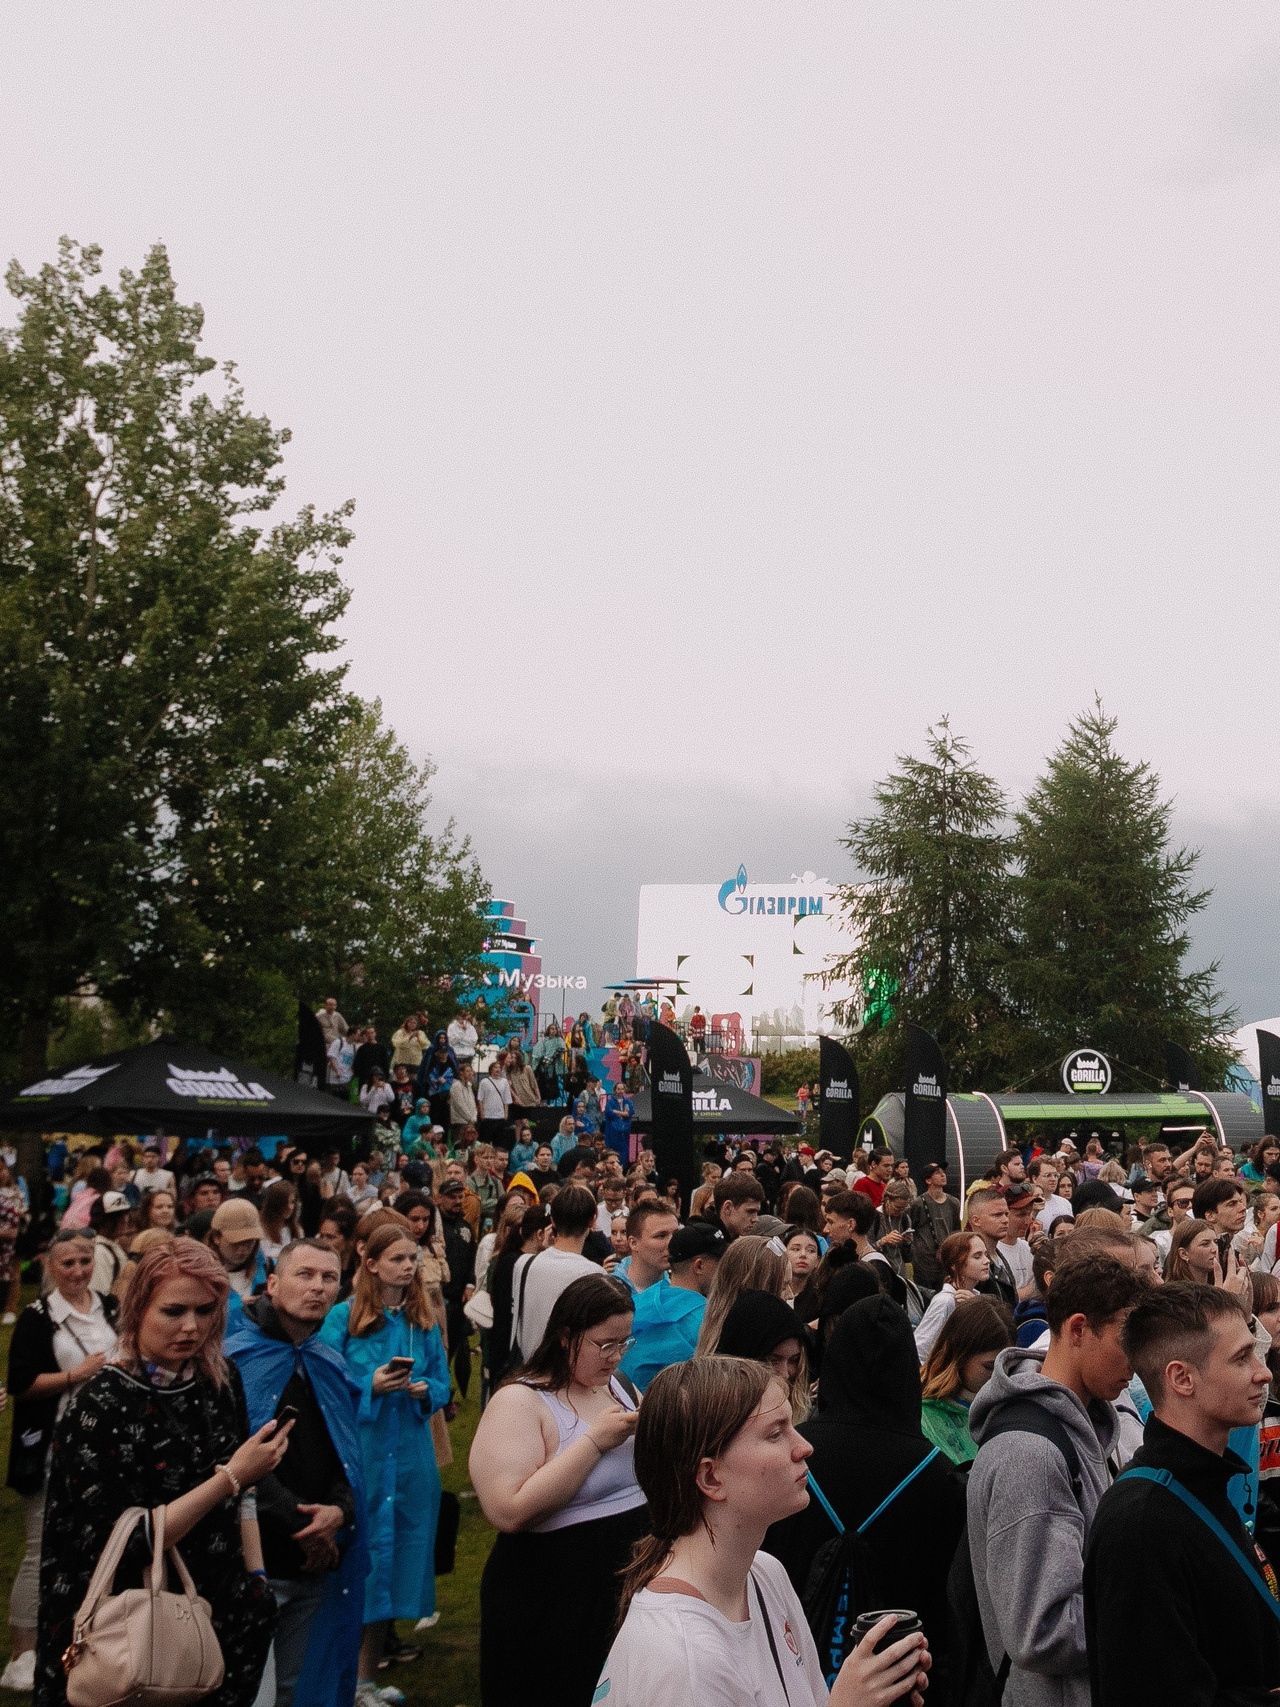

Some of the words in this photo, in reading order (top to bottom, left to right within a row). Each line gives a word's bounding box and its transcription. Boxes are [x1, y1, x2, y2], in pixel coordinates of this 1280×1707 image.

[498, 968, 588, 993] Музыка
[1070, 1069, 1106, 1082] GORILLA
[165, 1077, 276, 1101] GORILLA
[825, 1087, 853, 1099] GORILLA
[912, 1083, 942, 1098] GORILLA
